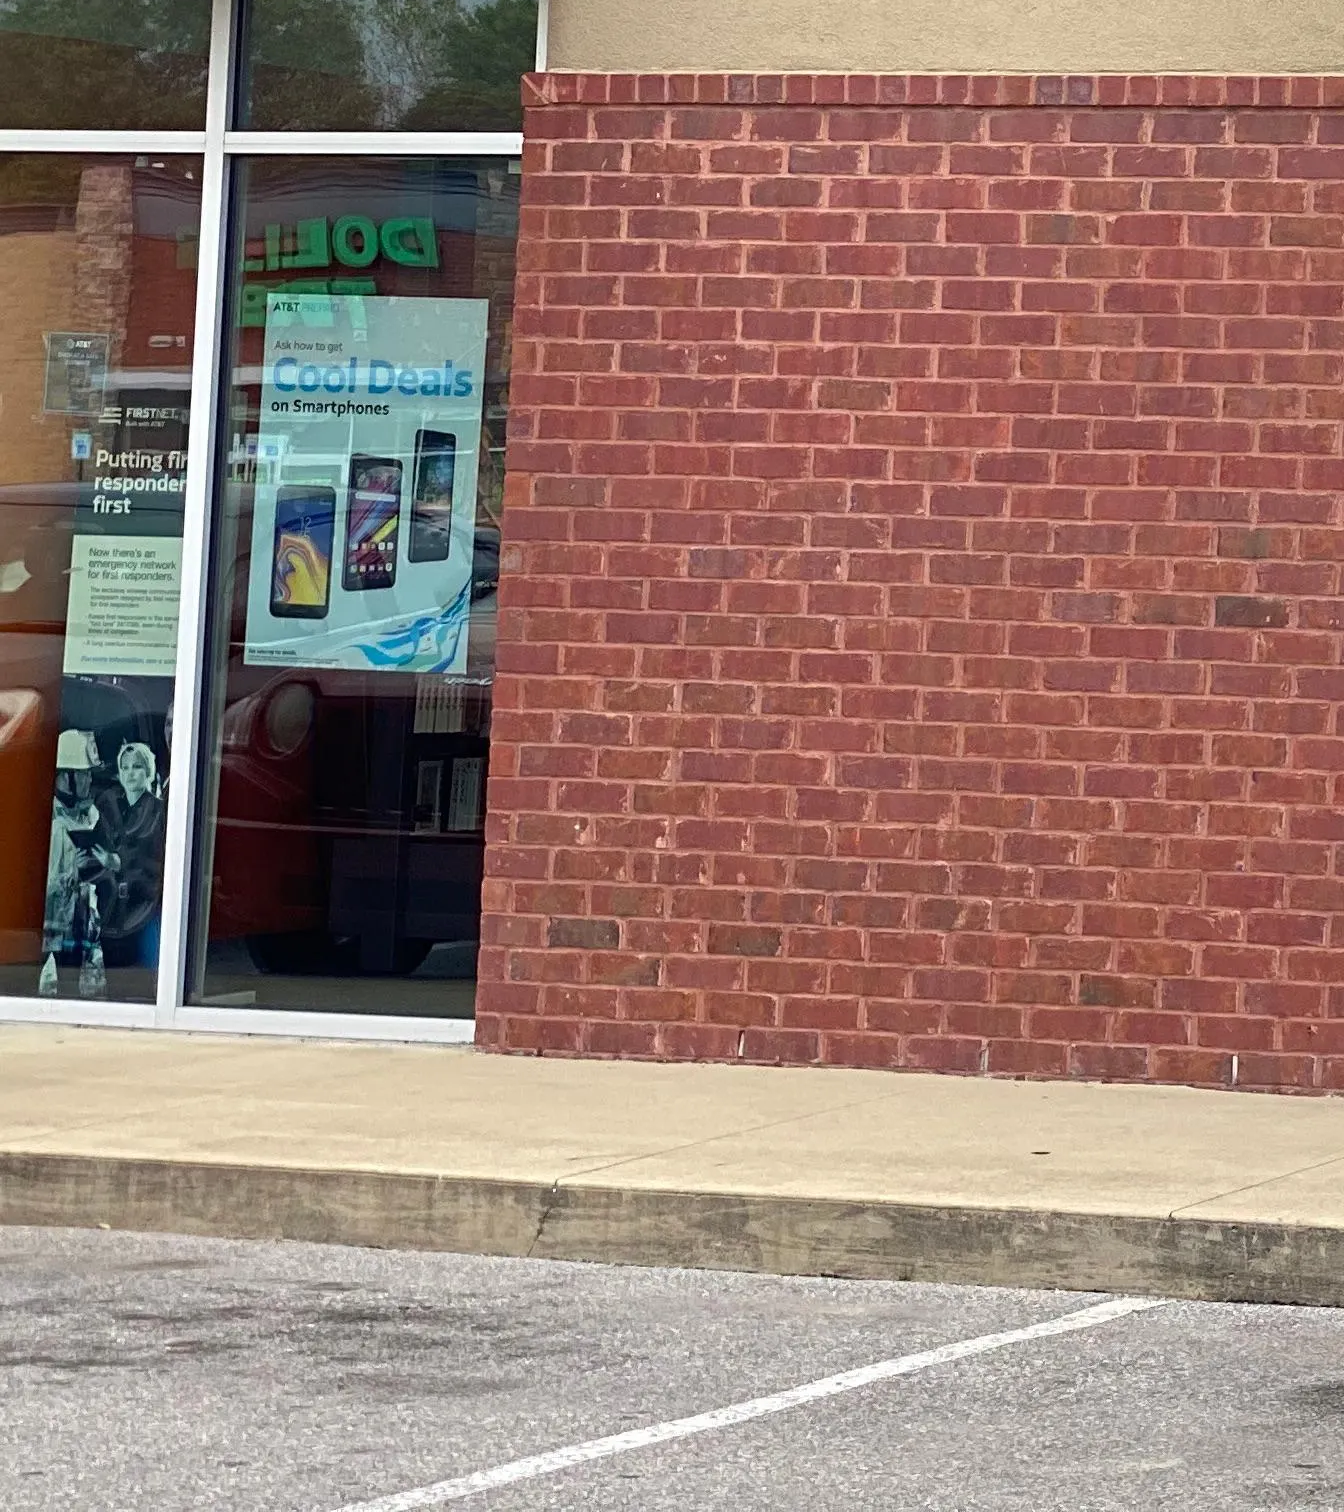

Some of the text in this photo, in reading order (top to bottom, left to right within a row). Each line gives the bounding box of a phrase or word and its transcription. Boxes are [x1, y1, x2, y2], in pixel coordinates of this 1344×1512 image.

[273, 302, 300, 312] AT&T
[274, 340, 343, 354] Ask how to get
[273, 357, 473, 397] Cool Deals
[271, 399, 390, 417] on Smartphones
[96, 450, 164, 472] Putting
[92, 495, 132, 514] first
[89, 548, 156, 558] Now there's an
[88, 560, 176, 571] emergency network
[87, 570, 100, 579] for
[102, 570, 119, 580] first
